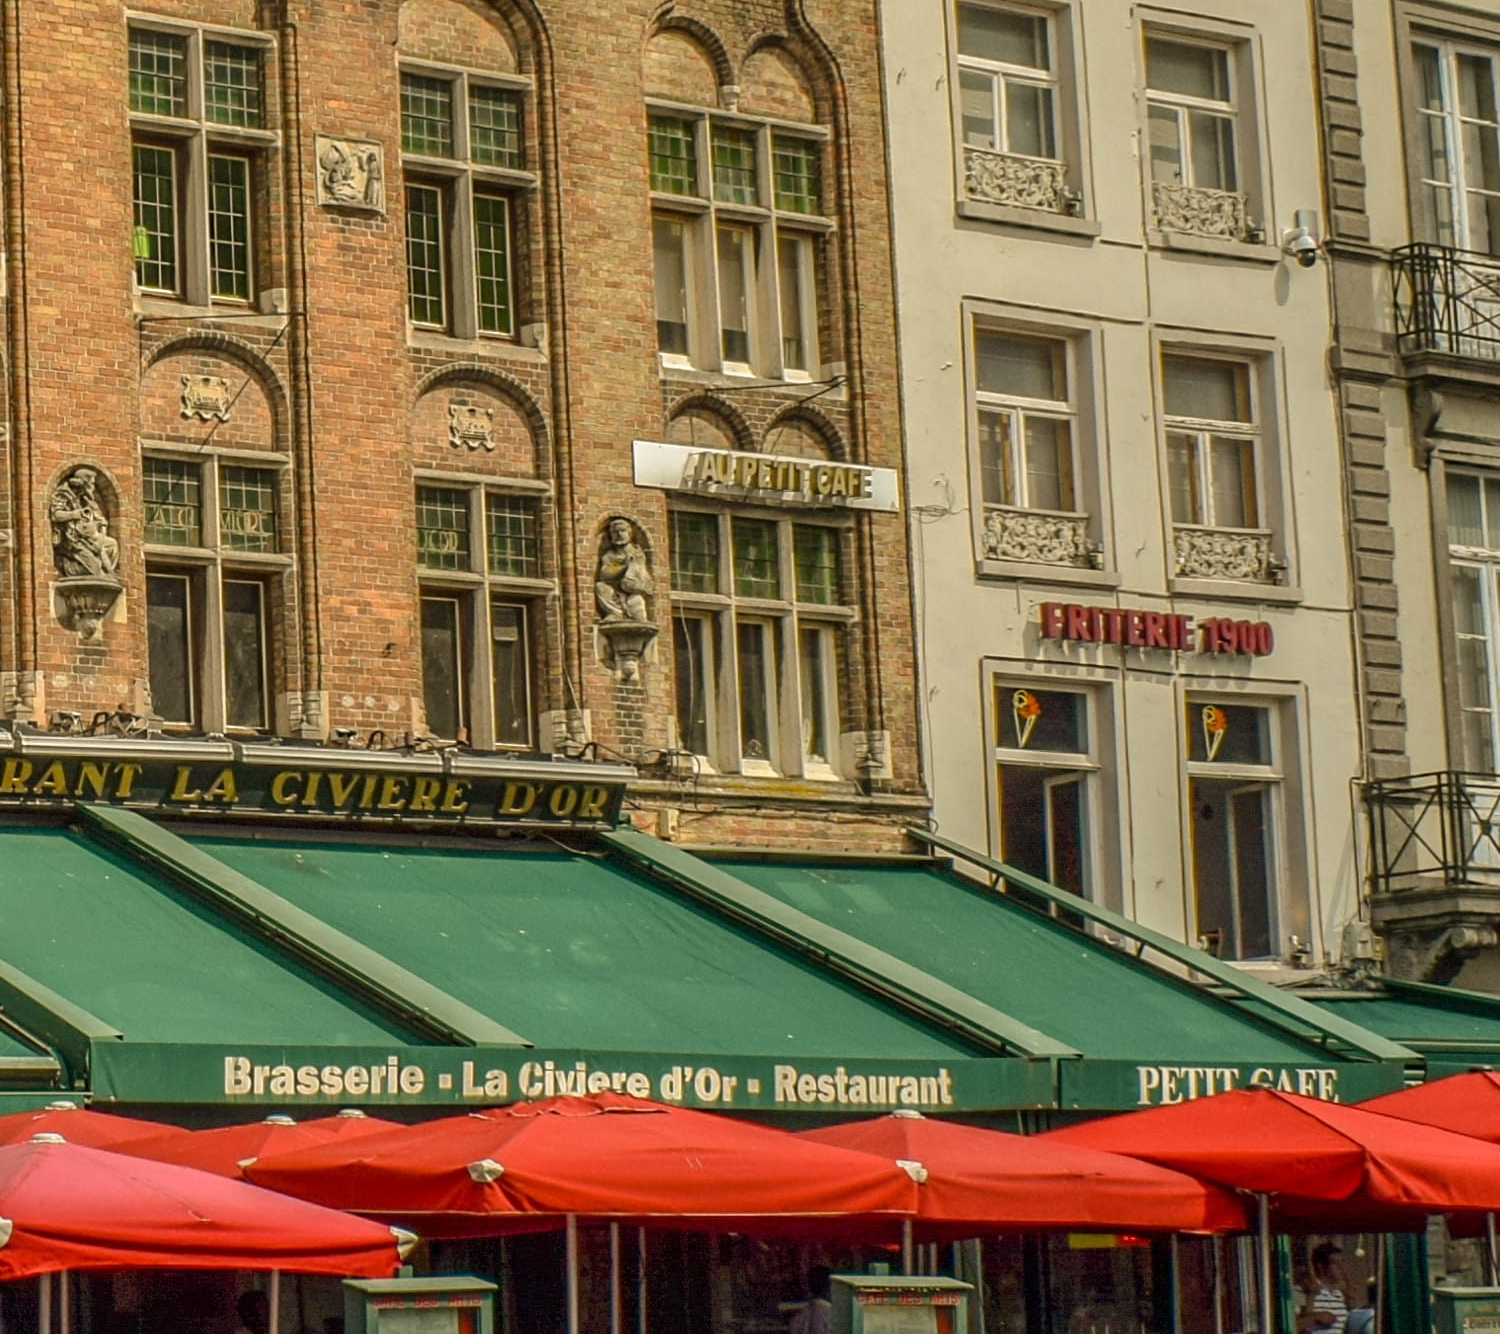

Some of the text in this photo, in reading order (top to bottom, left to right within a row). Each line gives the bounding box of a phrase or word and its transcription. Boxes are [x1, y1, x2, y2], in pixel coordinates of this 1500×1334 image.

[698, 452, 872, 498] AU PETIT CAFE
[1042, 603, 1273, 657] FRITERIE 1900
[172, 768, 239, 803] LA
[271, 771, 472, 813] CIVIERE
[500, 781, 610, 817] D'OR
[223, 1056, 953, 1105] Brasserie La Civiere d'Or Restaurant
[1137, 1066, 1239, 1105] PETIT
